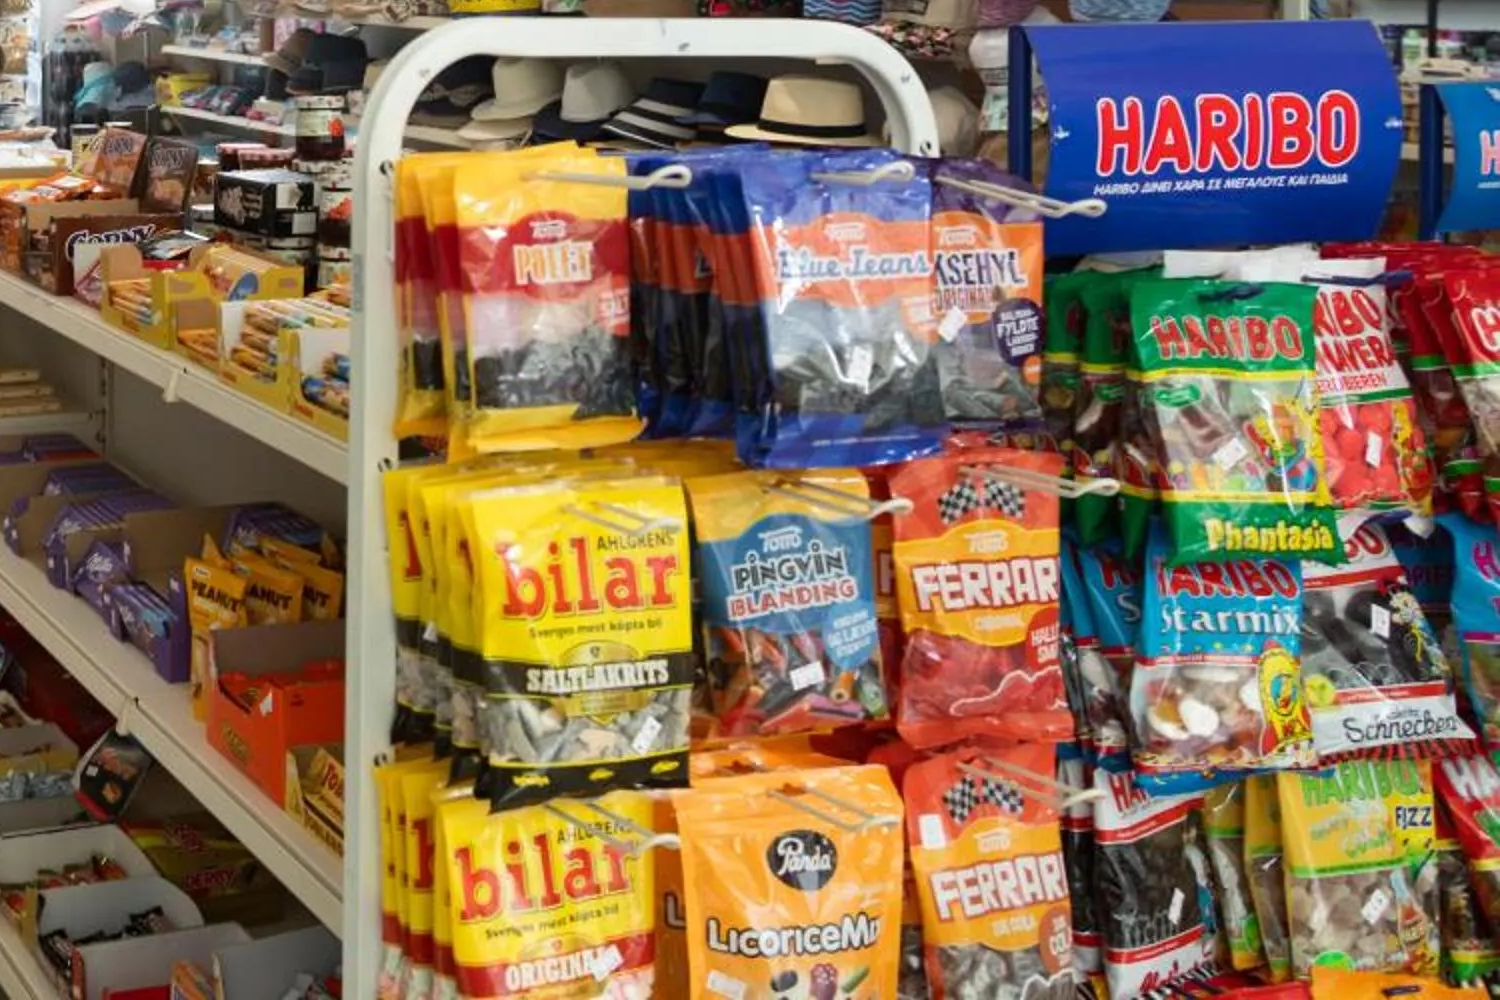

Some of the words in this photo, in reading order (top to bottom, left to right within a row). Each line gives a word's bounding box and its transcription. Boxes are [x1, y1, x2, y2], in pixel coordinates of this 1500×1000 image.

[1096, 89, 1360, 176] HARIBO
[1093, 182, 1140, 196] HARIBO
[844, 246, 931, 279] Jeans
[1151, 313, 1304, 361] HARIBO
[1205, 518, 1336, 552] Phantasia
[495, 536, 678, 619] bilar
[911, 556, 1060, 612] FERRAR
[727, 578, 858, 620] BLANDING
[1161, 605, 1301, 635] Starmix
[1395, 805, 1433, 830] FIZZ
[776, 836, 832, 876] Panda
[455, 832, 637, 922] bilar
